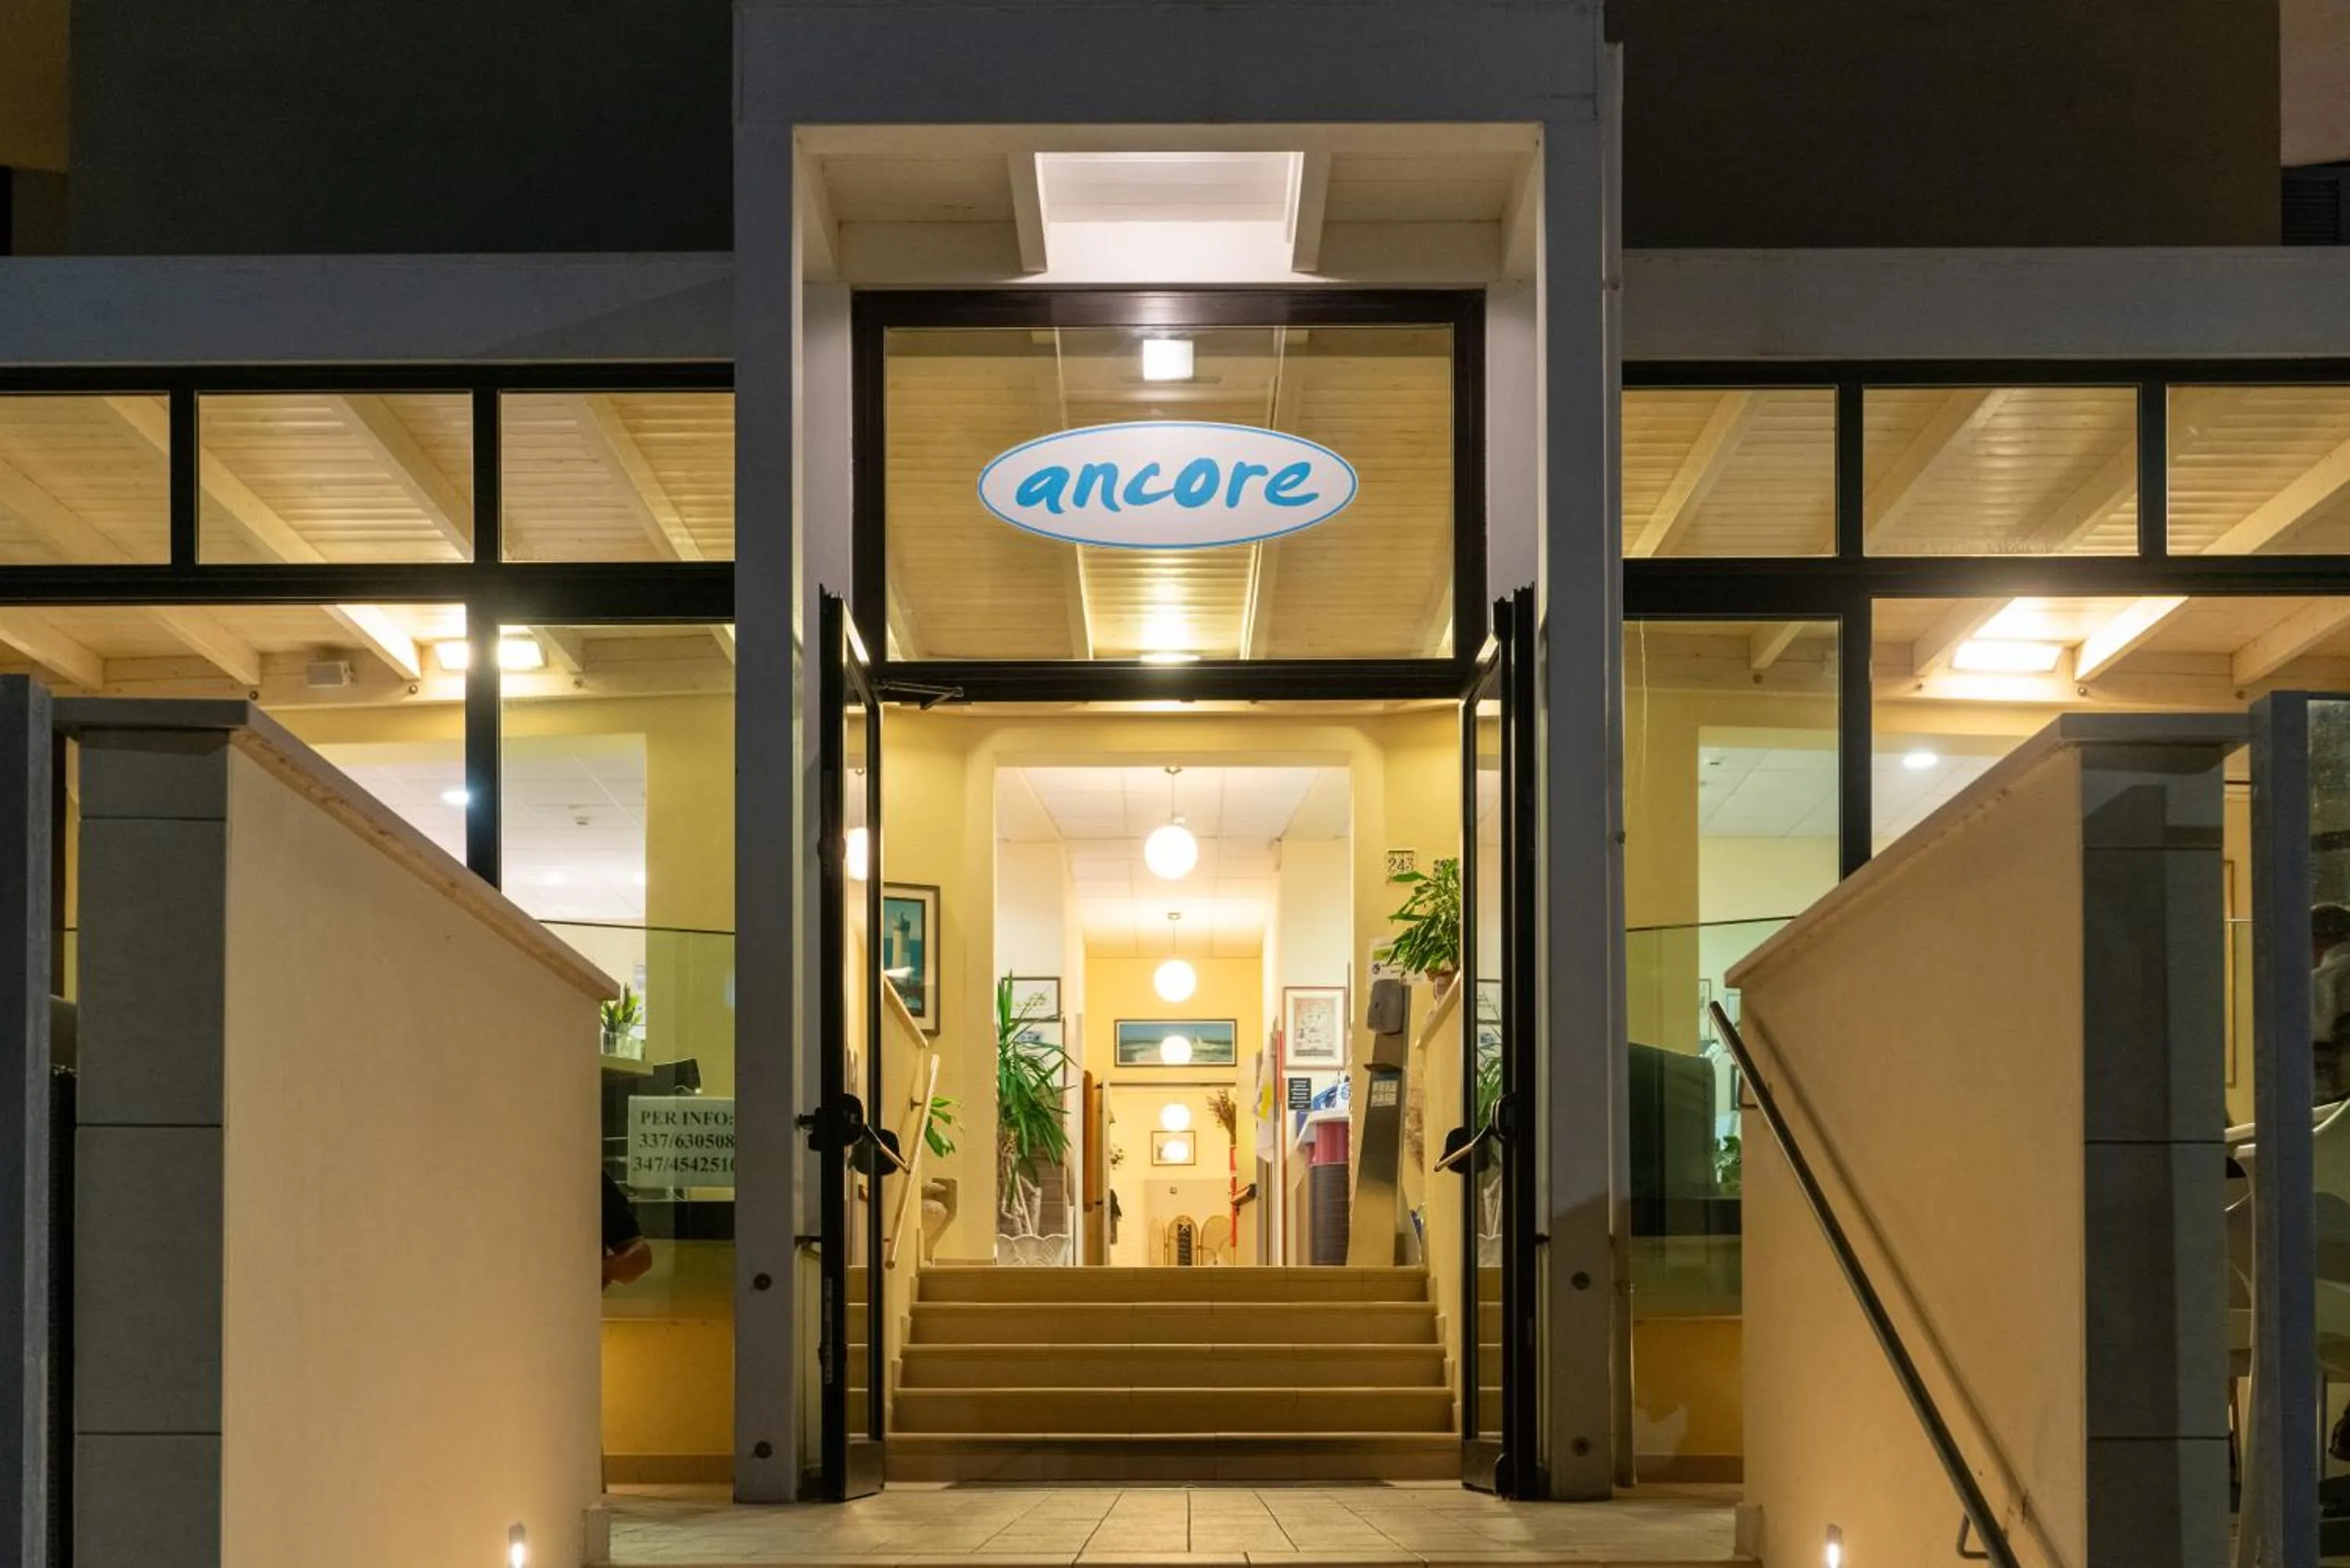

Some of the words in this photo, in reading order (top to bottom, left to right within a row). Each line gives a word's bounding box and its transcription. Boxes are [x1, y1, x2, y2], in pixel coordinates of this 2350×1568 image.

[1015, 457, 1319, 515] ancore
[641, 1111, 677, 1125] PER
[683, 1111, 734, 1125] INFO:
[638, 1133, 735, 1149] 337/630508
